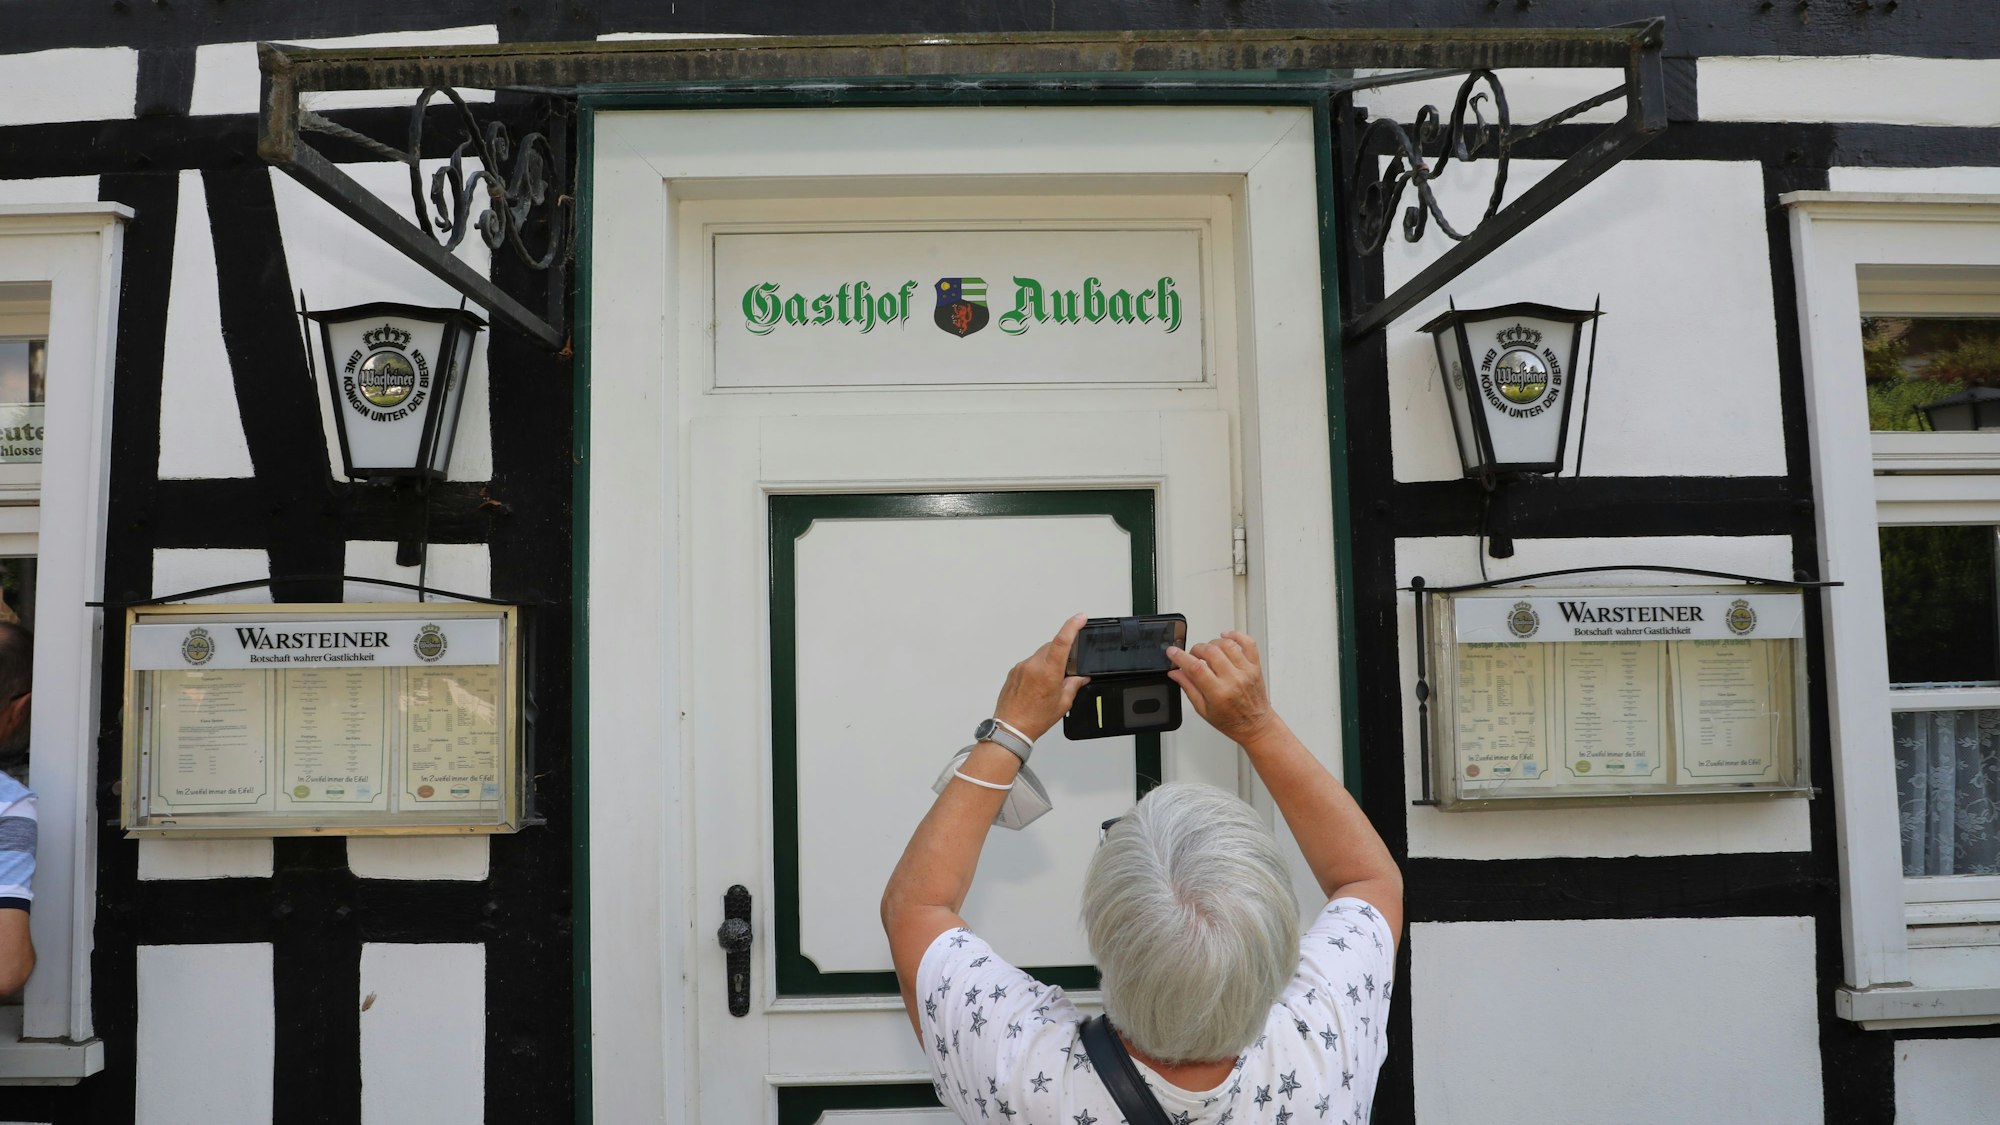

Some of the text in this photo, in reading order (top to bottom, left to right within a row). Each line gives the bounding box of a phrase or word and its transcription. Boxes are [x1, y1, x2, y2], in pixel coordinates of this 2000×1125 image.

[742, 275, 1183, 335] Gasthof Aubach
[1481, 348, 1498, 373] EINE
[1542, 347, 1562, 386] BIEREN
[343, 349, 430, 422] EINE KÖNIGIN UNTER DEN BIEREN
[1481, 374, 1508, 413] KÖNIGIN
[1542, 387, 1560, 409] DEN
[1508, 405, 1544, 419] UNTER
[0, 445, 42, 456] hlosse
[1558, 601, 1704, 623] WARSTEINER
[235, 627, 390, 649] WARSTEINER
[1574, 626, 1691, 636] Botschaft wahrer Gastlichkeit
[250, 652, 375, 663] Botschaft wahrer Gastlichkeit
